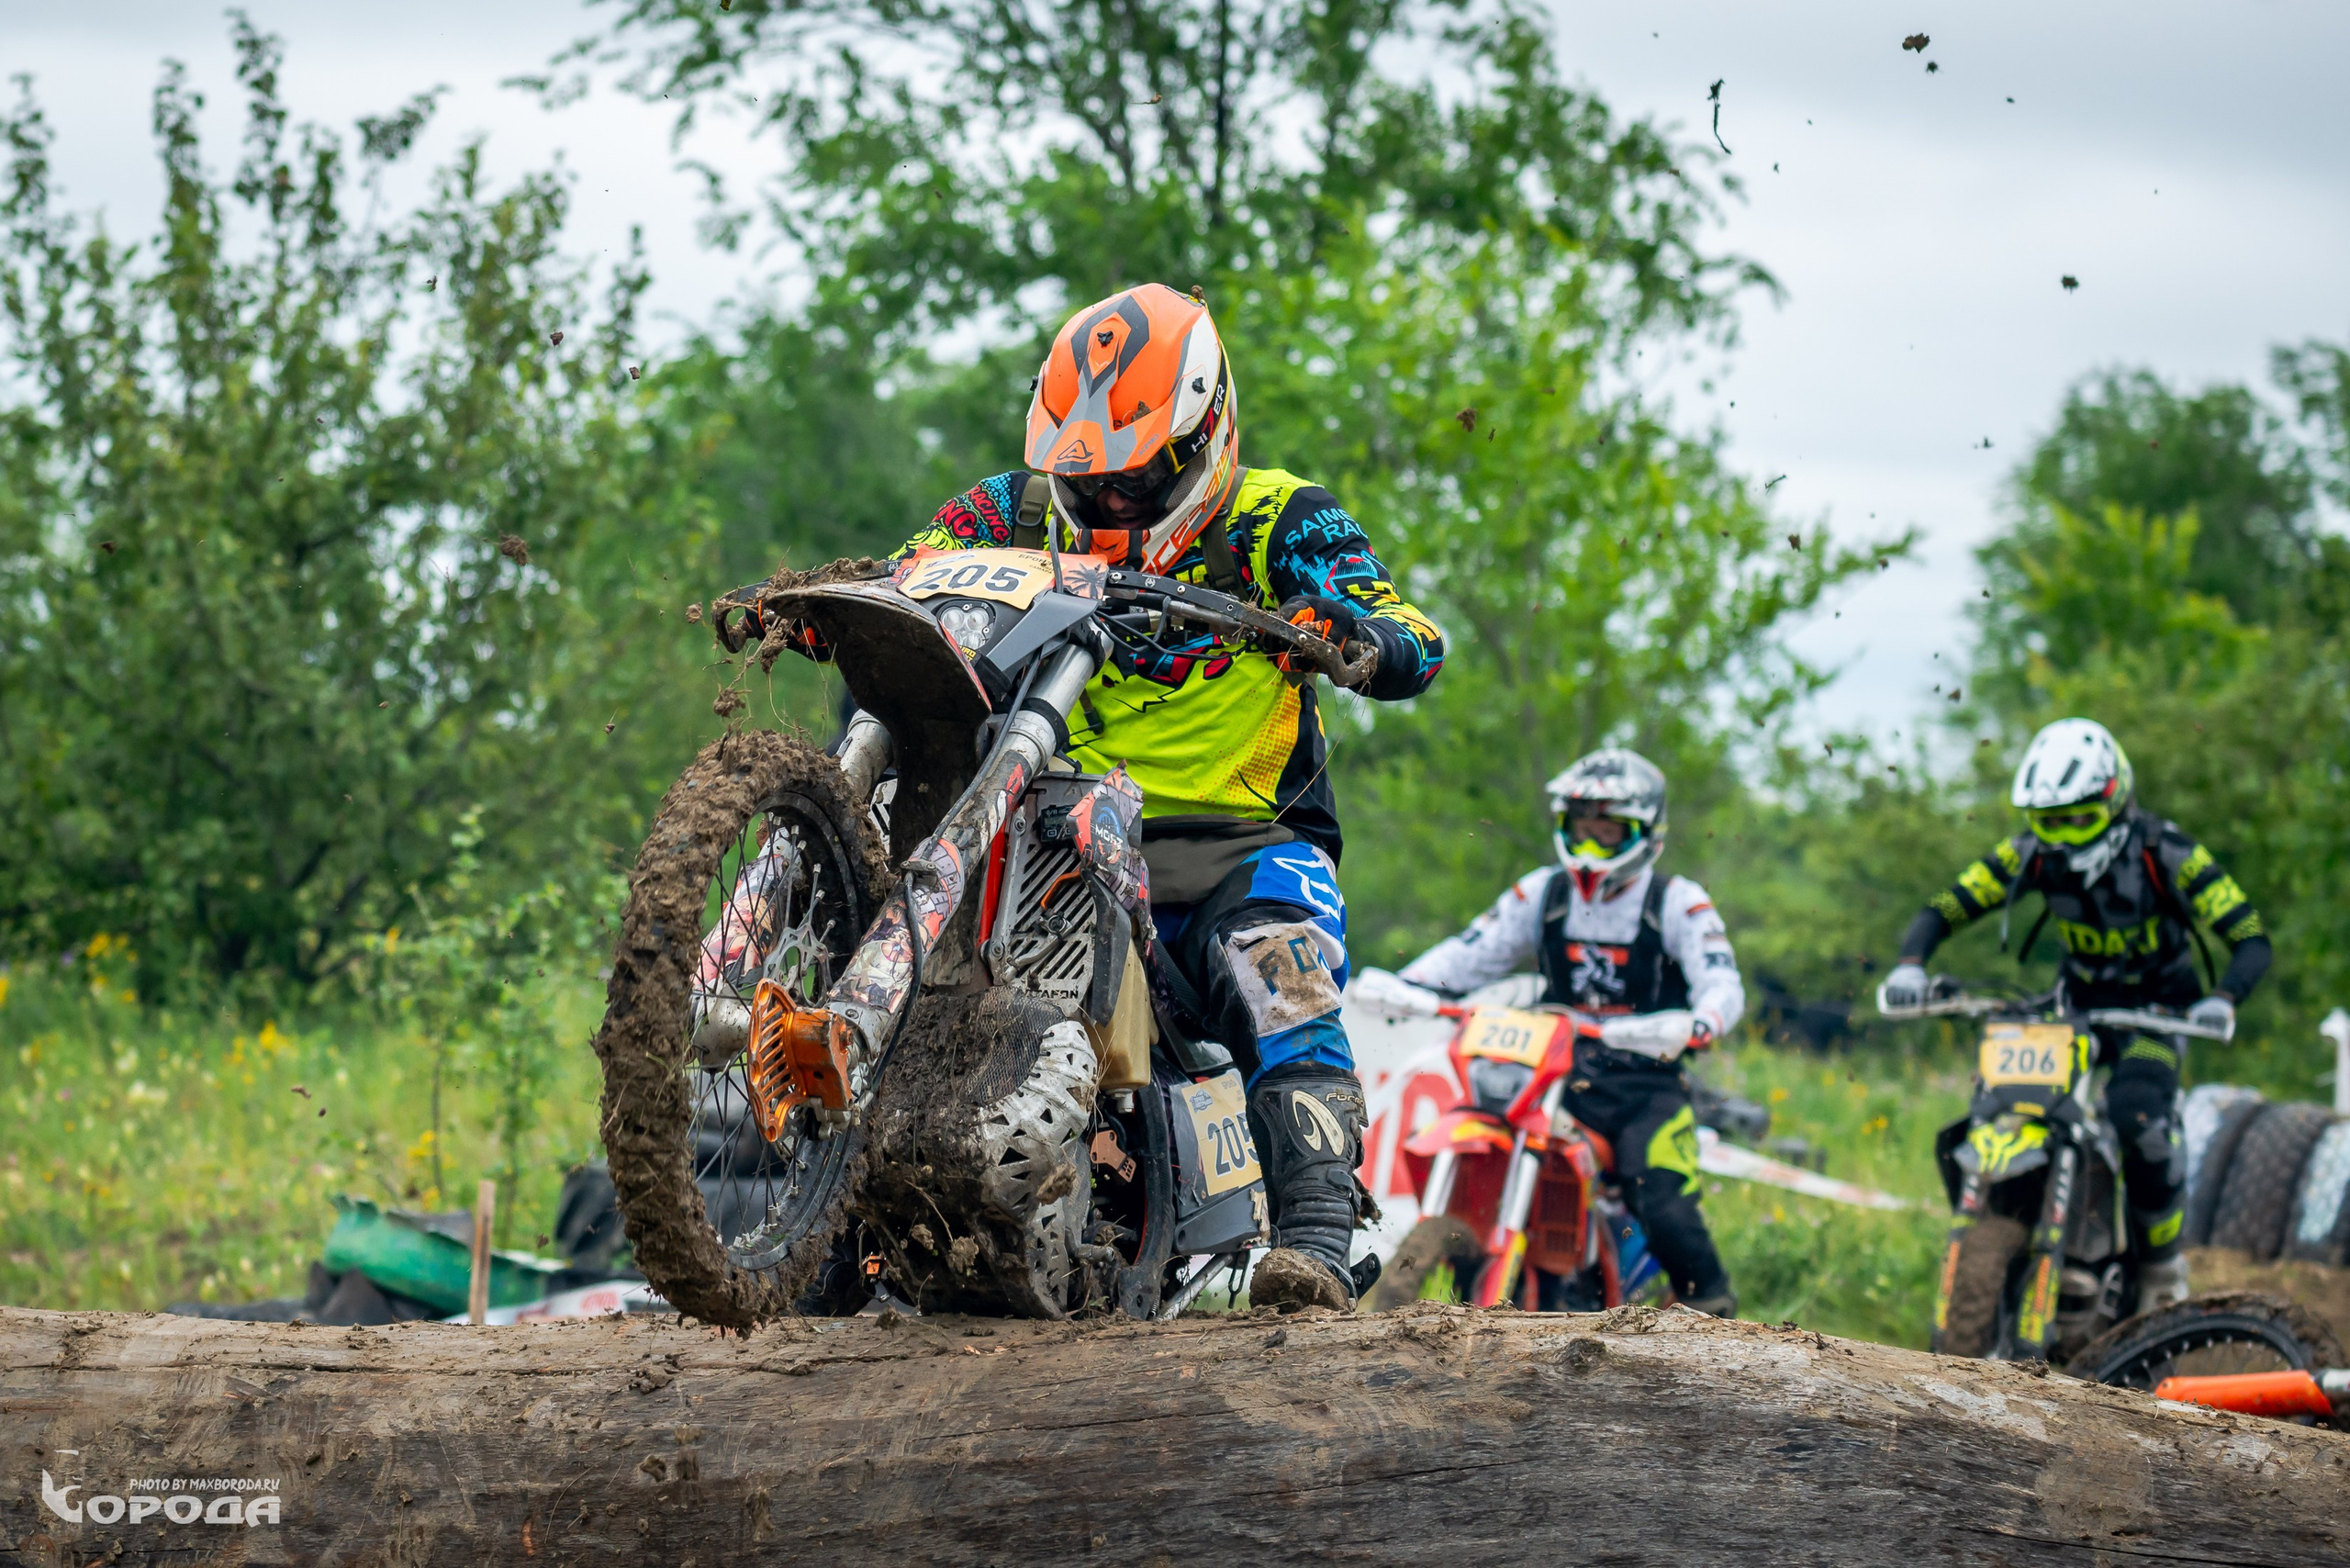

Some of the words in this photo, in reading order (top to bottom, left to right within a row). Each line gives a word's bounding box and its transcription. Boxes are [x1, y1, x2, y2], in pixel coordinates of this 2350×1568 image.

[967, 486, 1009, 542] RACING
[1285, 508, 1350, 550] SAIME
[1322, 520, 1368, 543] RAC
[909, 564, 1028, 592] 205
[1258, 935, 1318, 996] FO
[1480, 1025, 1533, 1053] 201
[1998, 1047, 2056, 1075] 206
[1207, 1113, 1259, 1176] 205
